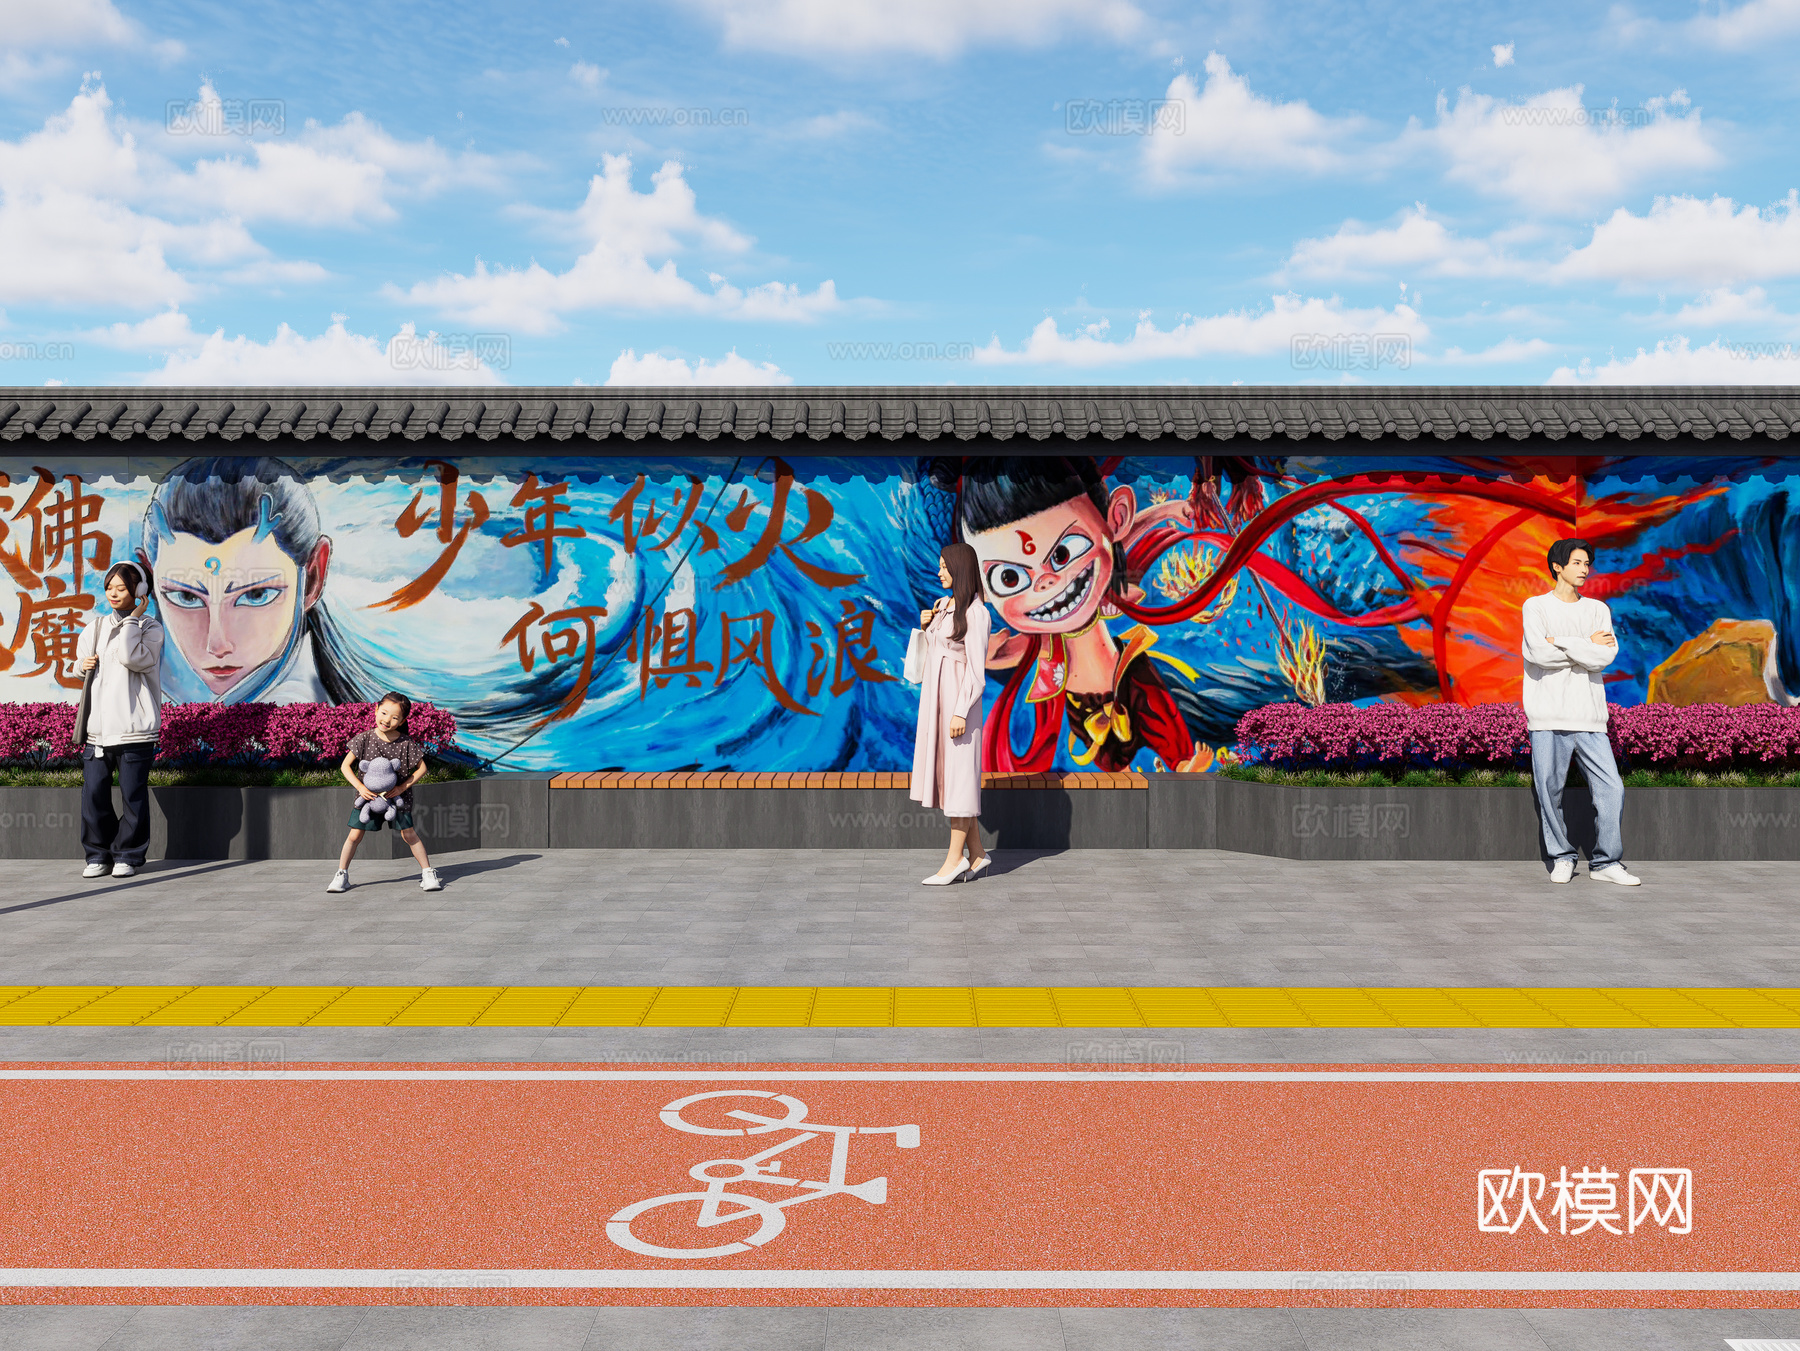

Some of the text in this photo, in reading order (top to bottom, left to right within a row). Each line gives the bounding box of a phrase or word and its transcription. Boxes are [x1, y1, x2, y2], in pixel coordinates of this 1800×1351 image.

[359, 456, 866, 613] 少年似火
[498, 600, 899, 730] 何惧风浪
